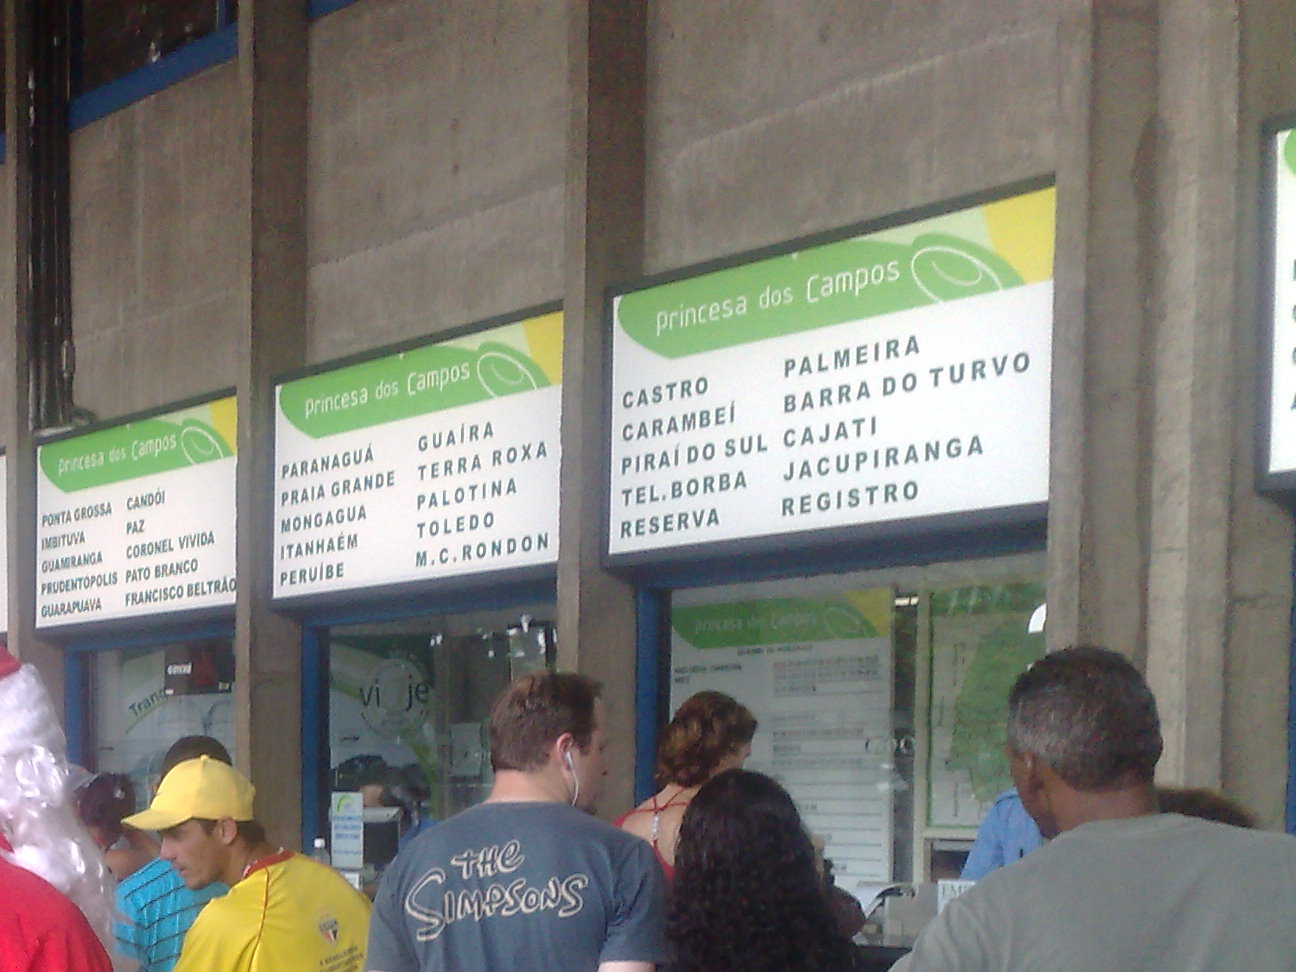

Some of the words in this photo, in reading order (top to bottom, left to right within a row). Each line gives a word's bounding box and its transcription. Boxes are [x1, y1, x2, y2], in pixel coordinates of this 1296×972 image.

[759, 285, 793, 309] dos
[807, 260, 900, 303] Campos
[784, 335, 920, 378] PALMEIRA
[375, 380, 398, 400] dos
[407, 362, 470, 396] Campos
[622, 377, 709, 409] CASTRO
[784, 381, 871, 413] BARRA
[882, 373, 917, 397] DO
[929, 352, 1030, 388] TURVO
[418, 421, 494, 451] GUAÍRA
[622, 401, 736, 441] CARAMBEÍ
[783, 416, 877, 447] CAJATI
[109, 446, 126, 462] dos
[132, 434, 177, 460] Campos
[281, 442, 374, 479] PARANAGUÁ
[418, 454, 481, 480] TERRA
[492, 441, 547, 467] ROXA
[621, 442, 680, 475] PIRAÍ
[687, 443, 715, 464] DO
[724, 434, 768, 457] SUL
[783, 434, 983, 481] JACUPIRANGA
[126, 488, 165, 510] CANDÓI
[281, 485, 325, 506] PRAIA
[331, 470, 395, 497] GRANDE
[417, 478, 517, 510] PALOTINA
[781, 481, 919, 516] REGISTRO
[42, 510, 72, 527] PONTA
[74, 502, 112, 522] GROSSA
[126, 520, 145, 535] PAZ
[417, 512, 494, 539] TOLEDO
[620, 508, 720, 539] RESERVA
[41, 531, 85, 550] IMBITUVA
[126, 538, 174, 559] CORONEL
[178, 530, 215, 550] VIVIDA
[281, 532, 358, 560] ITANHAÉM
[41, 551, 103, 573] GUAMIRANGA
[125, 567, 150, 583] PATO
[154, 558, 198, 579] BRANCO
[280, 562, 344, 587] PERUÍBE
[125, 584, 184, 606] FRANCISCO
[187, 576, 236, 597] BELTRÃO
[41, 597, 102, 618] GUARAPUAVA
